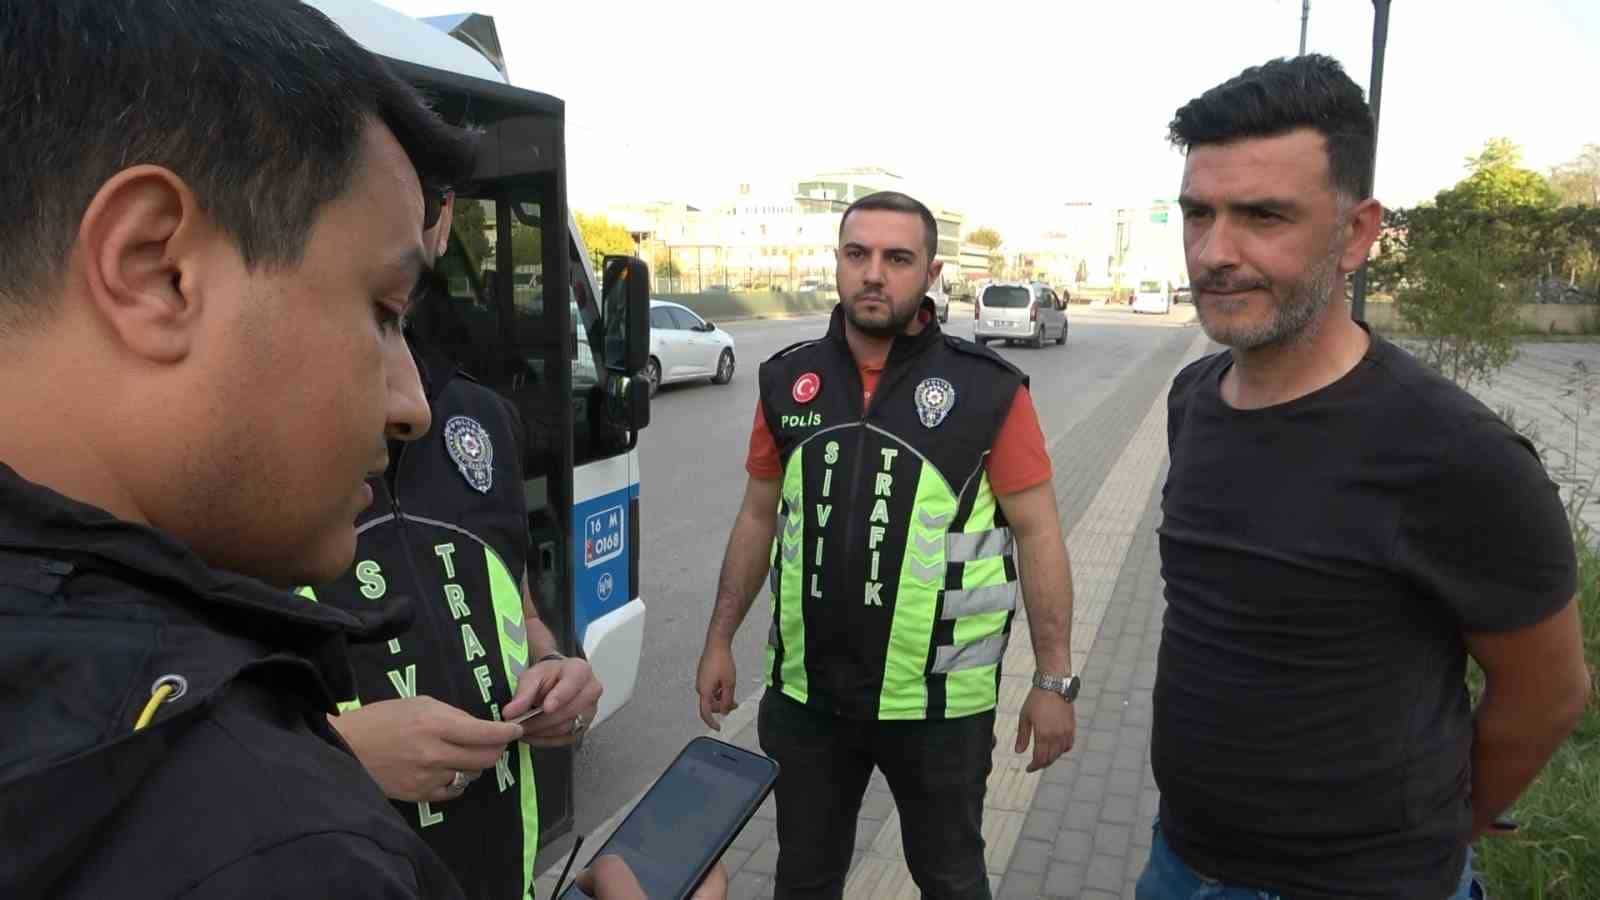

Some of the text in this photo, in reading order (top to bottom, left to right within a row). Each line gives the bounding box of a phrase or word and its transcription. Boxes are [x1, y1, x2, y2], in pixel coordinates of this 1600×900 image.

[590, 512, 618, 534] 16 M
[356, 560, 444, 829] SVL
